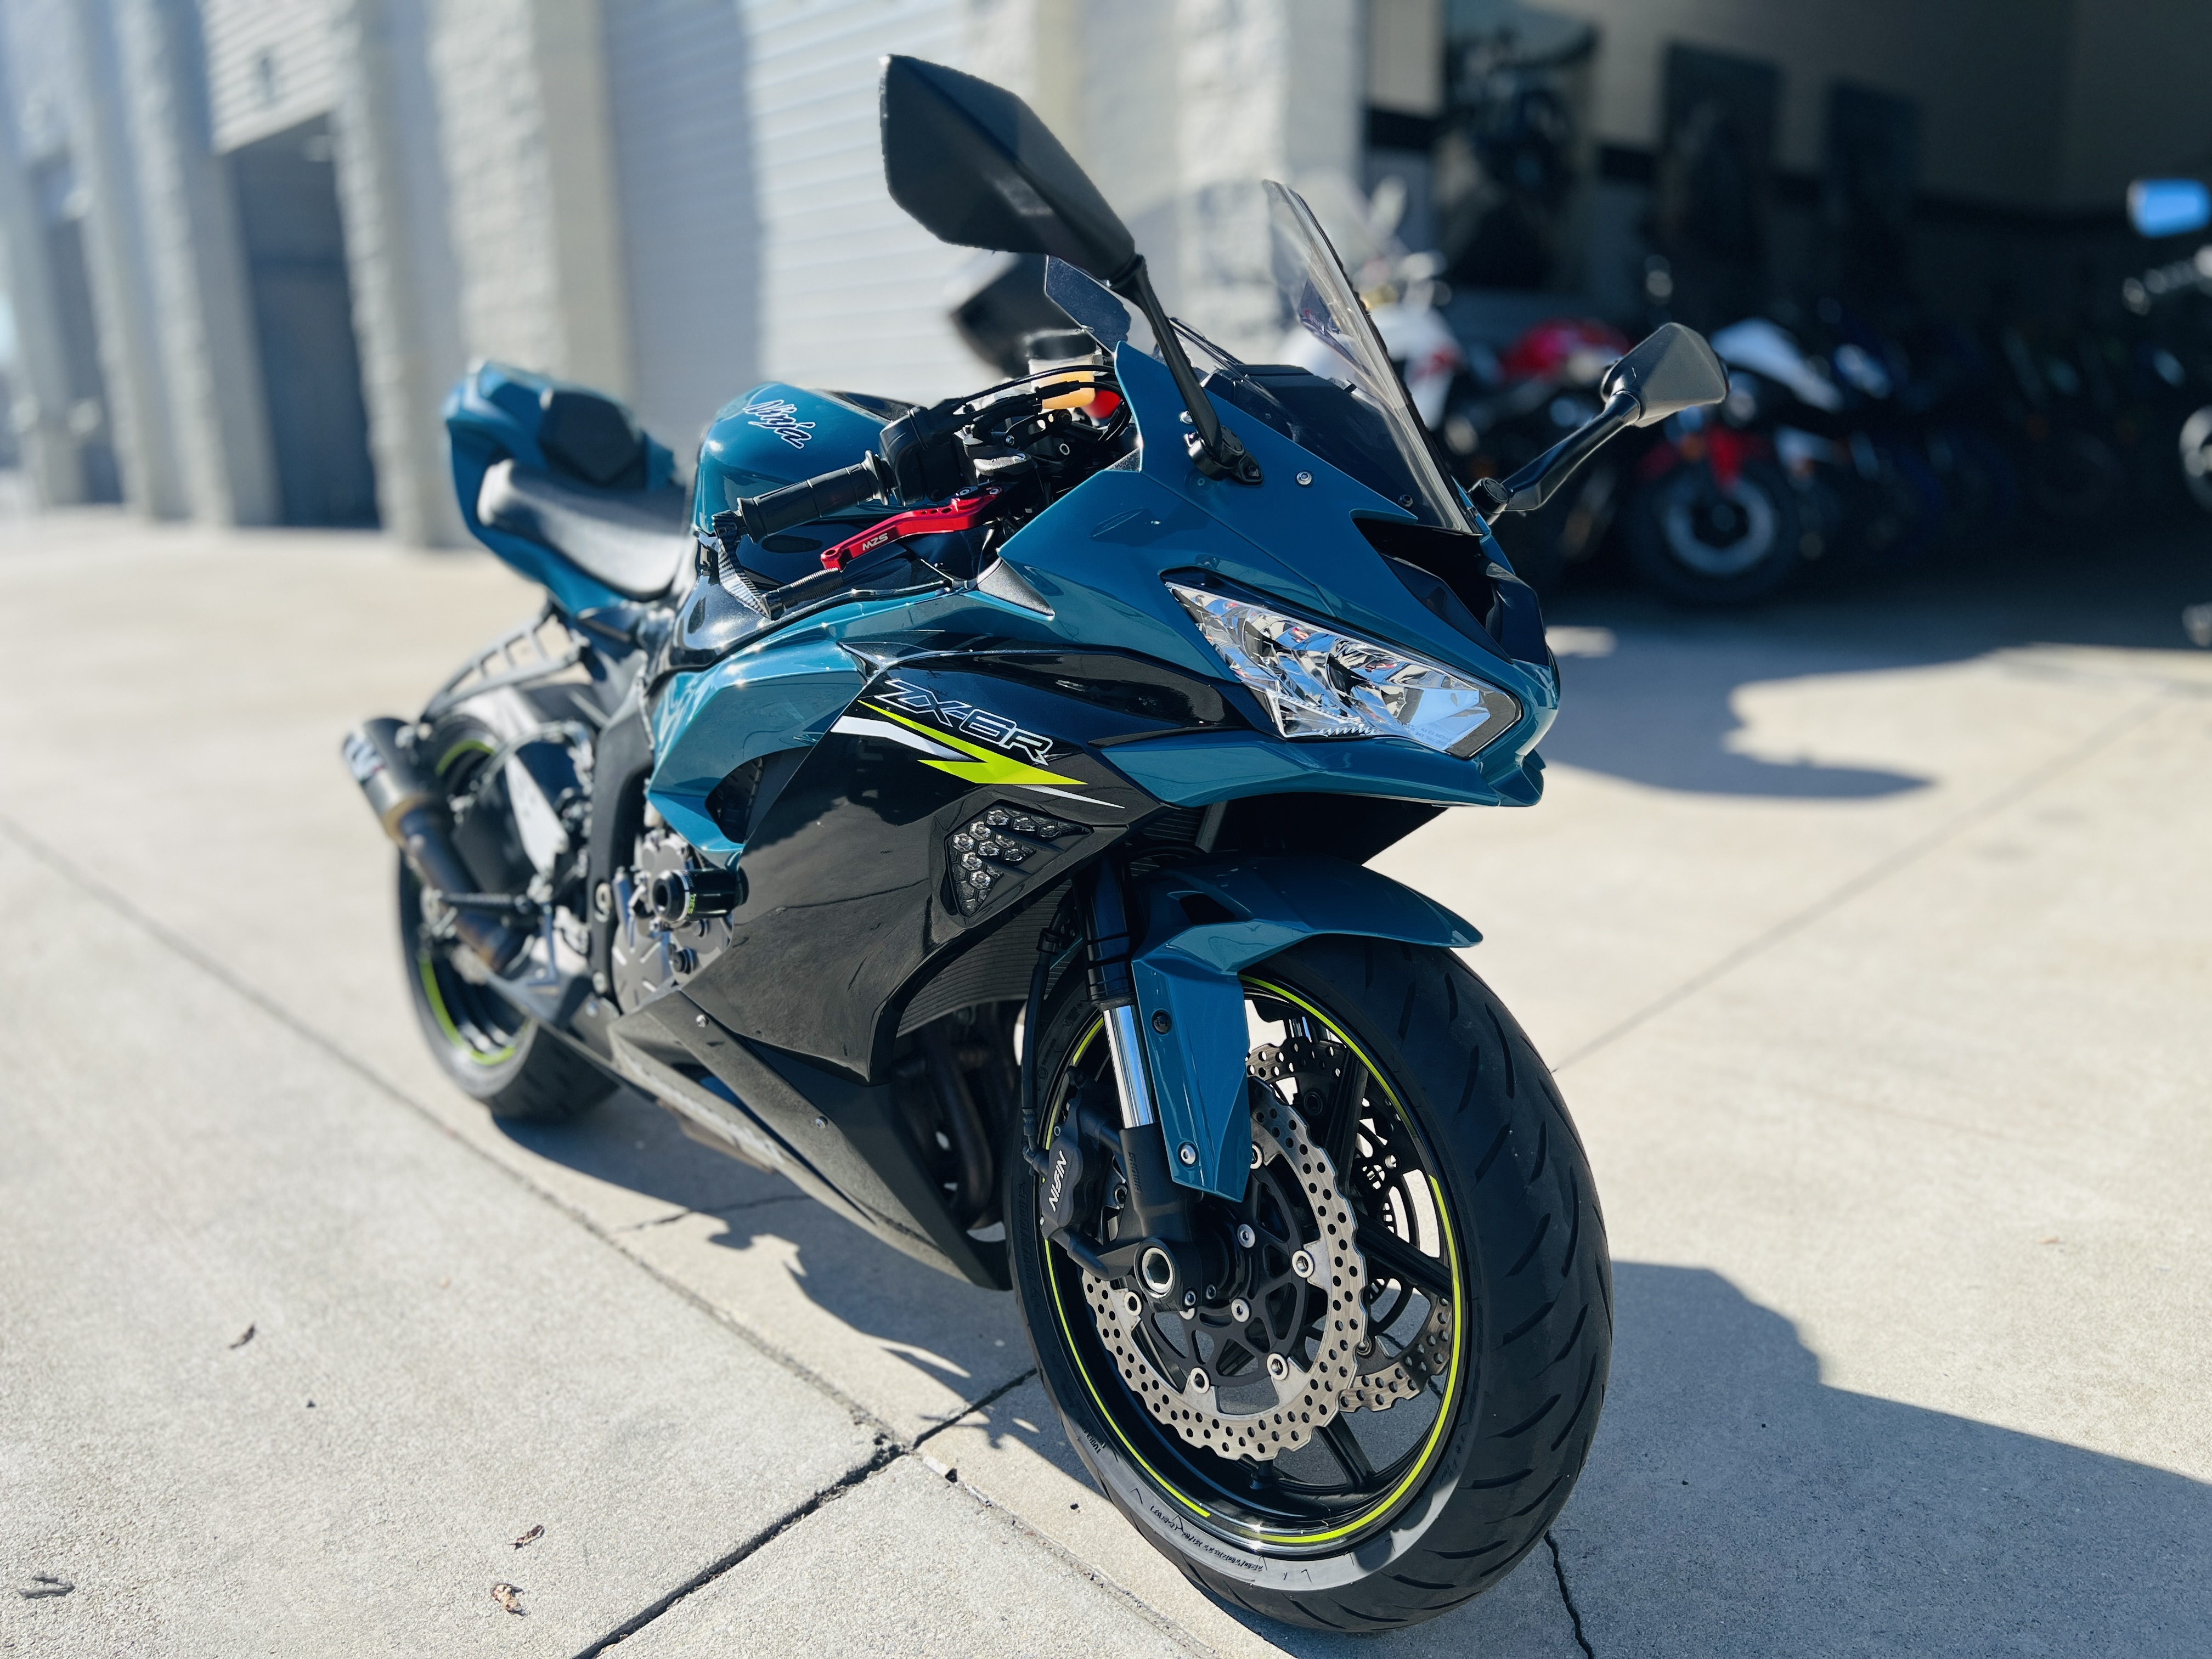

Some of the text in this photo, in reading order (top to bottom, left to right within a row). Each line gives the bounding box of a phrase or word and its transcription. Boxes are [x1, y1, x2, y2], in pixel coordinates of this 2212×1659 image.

[742, 399, 816, 449] Ninja
[862, 533, 888, 551] MZS
[874, 678, 1053, 766] ZX-6R
[1017, 1181, 1036, 1283] DUNLOP
